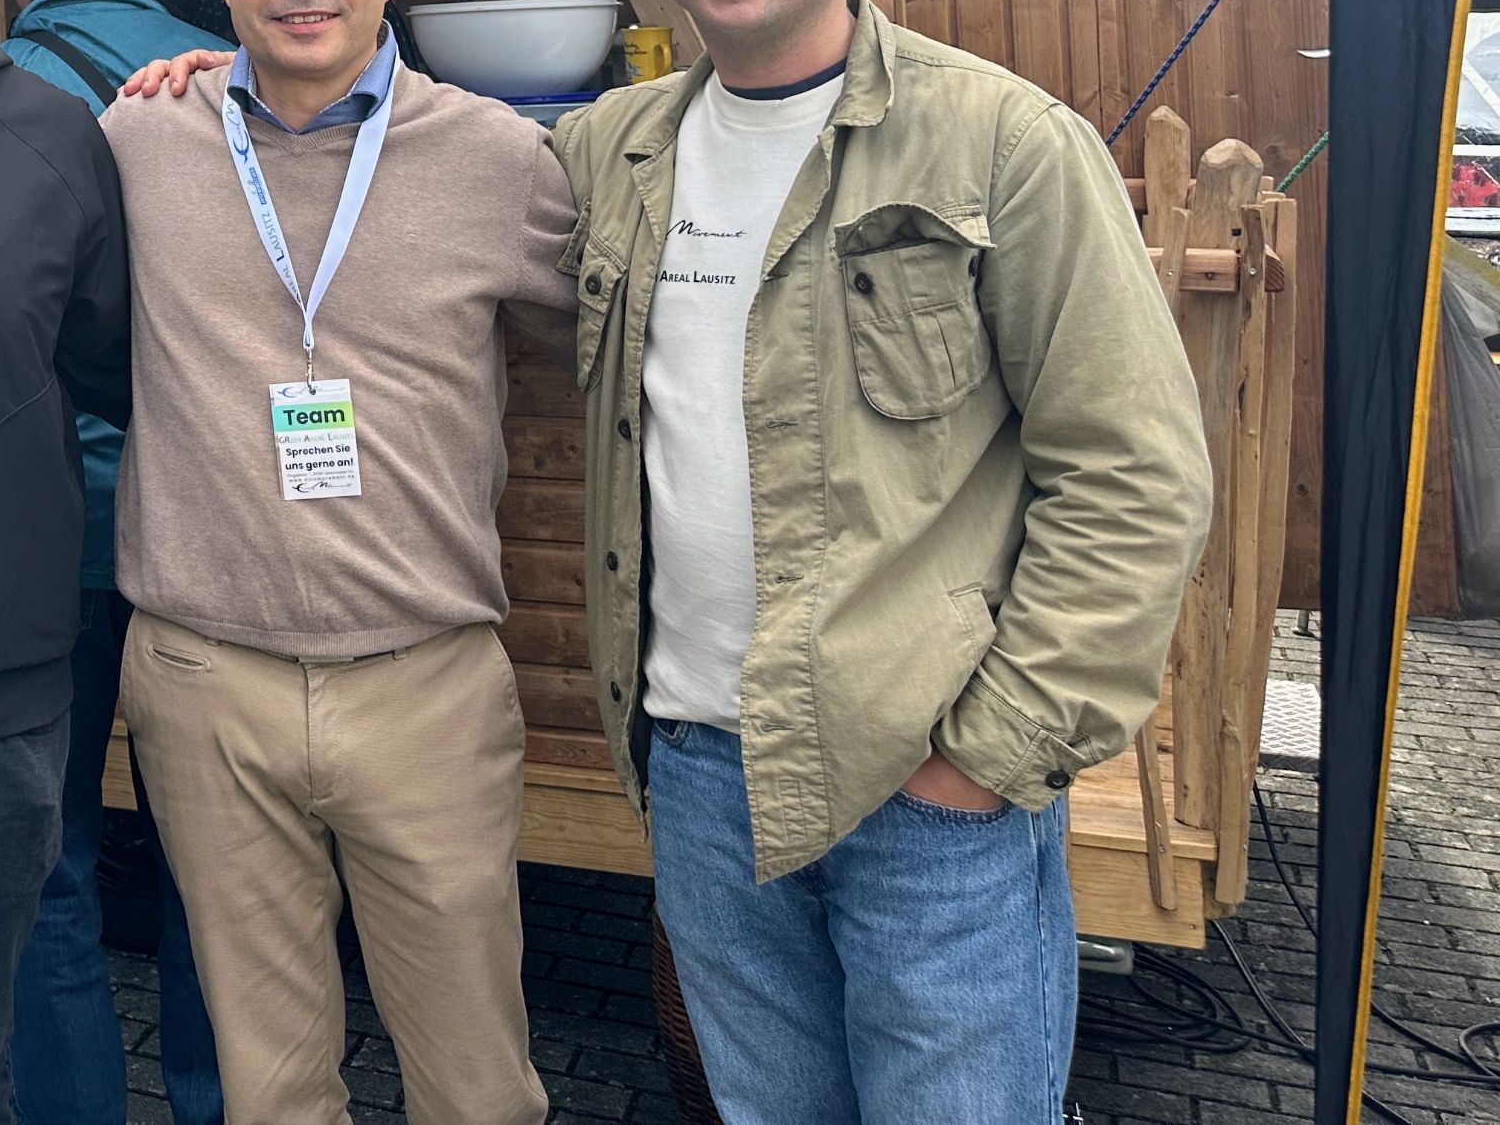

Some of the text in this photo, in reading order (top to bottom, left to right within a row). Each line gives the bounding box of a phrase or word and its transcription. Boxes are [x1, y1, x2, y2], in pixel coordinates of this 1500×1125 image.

[283, 409, 345, 426] Team
[285, 443, 351, 458] Sprechen Sie
[285, 457, 354, 471] uns gerne an!
